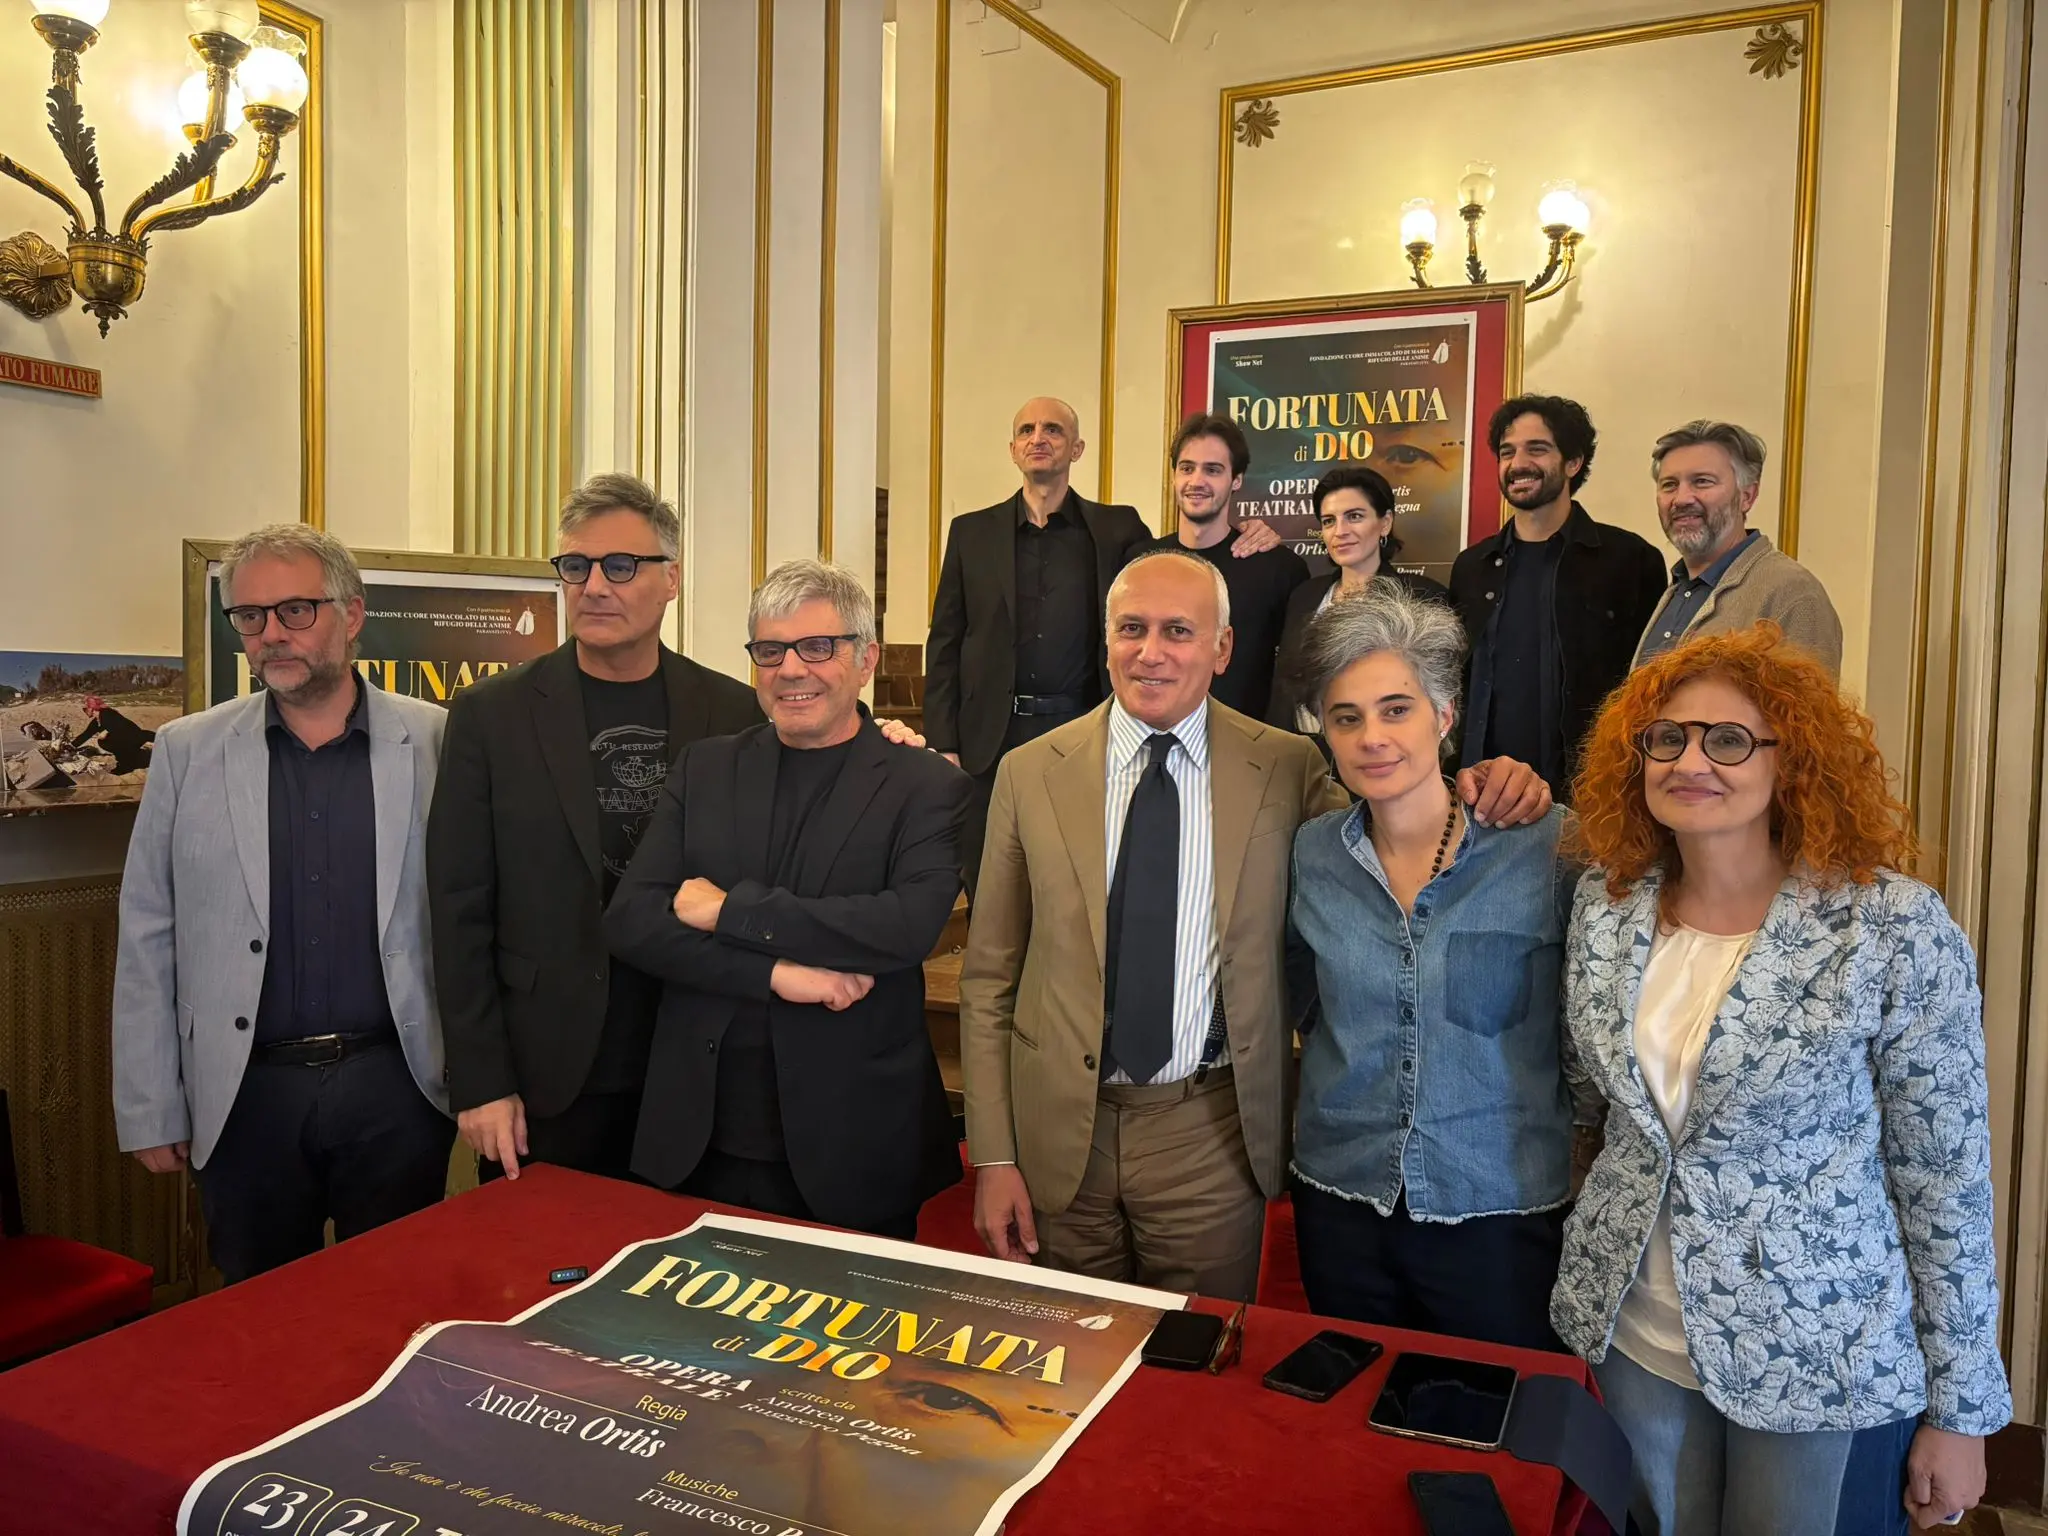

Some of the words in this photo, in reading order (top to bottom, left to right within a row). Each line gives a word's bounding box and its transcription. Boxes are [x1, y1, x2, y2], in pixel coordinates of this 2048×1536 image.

[0, 356, 24, 379] TO
[31, 362, 97, 392] FUMARE
[1228, 387, 1449, 432] FORTUNATA
[1294, 446, 1308, 462] di
[1313, 430, 1374, 462] DIO
[1269, 478, 1320, 496] OPER
[1391, 485, 1411, 497] rtis
[1394, 503, 1421, 515] egna
[364, 610, 402, 618] NDAZIONE
[403, 611, 428, 619] CUORE
[429, 612, 478, 620] IMMACOLATO
[434, 620, 464, 628] RIFUGIO
[621, 1254, 1067, 1385] FORTUNATA
[1041, 1306, 1075, 1317] MARIA
[712, 1336, 750, 1353] di
[748, 1333, 892, 1381] DIO
[619, 1354, 753, 1392] OPERA
[635, 1394, 688, 1421] Regia
[779, 1387, 831, 1405] scritta
[834, 1399, 856, 1411] da
[465, 1384, 577, 1435] Andrea
[579, 1416, 667, 1458] Ortis
[738, 1403, 839, 1433] Ruggero
[756, 1396, 846, 1423] Andrea
[849, 1418, 917, 1441] Ortis
[460, 1486, 491, 1499] che
[660, 1470, 739, 1500] Musiche
[243, 1483, 309, 1529] 23
[635, 1488, 771, 1535] Francesco
